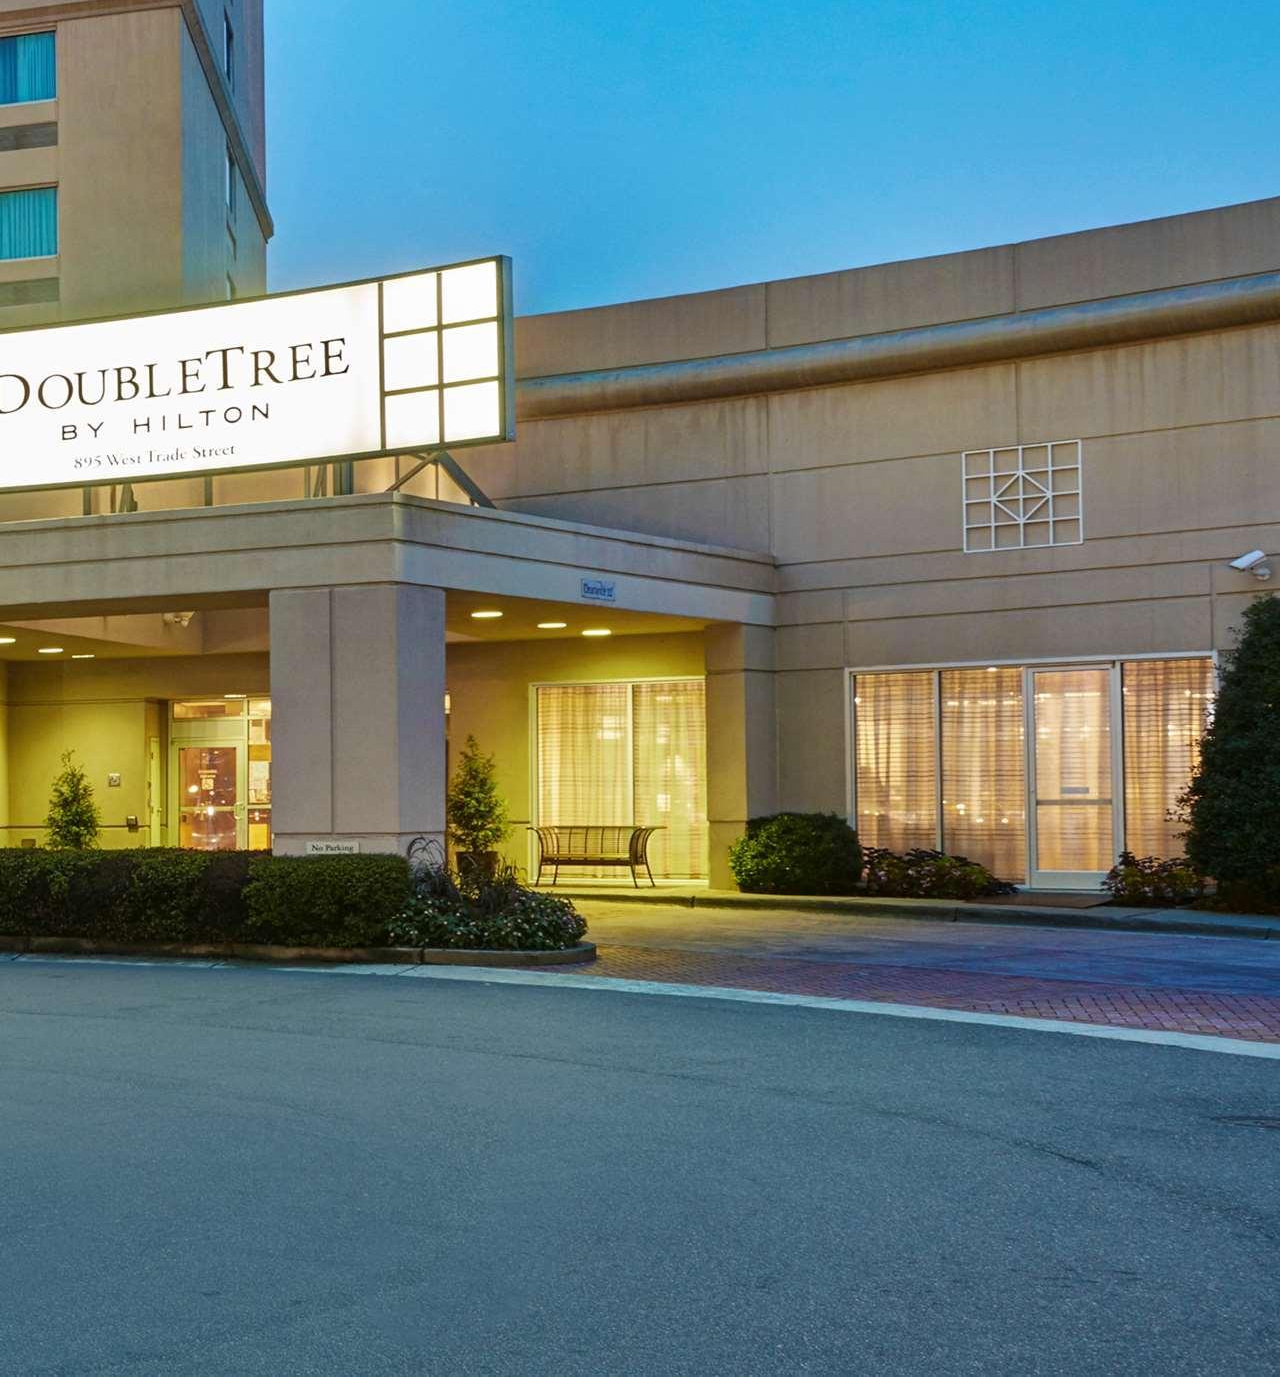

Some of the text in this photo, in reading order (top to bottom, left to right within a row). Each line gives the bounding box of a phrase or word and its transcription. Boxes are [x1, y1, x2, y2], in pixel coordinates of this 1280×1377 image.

[61, 403, 269, 441] BY HILTON
[74, 444, 236, 470] 895 West Trade Street
